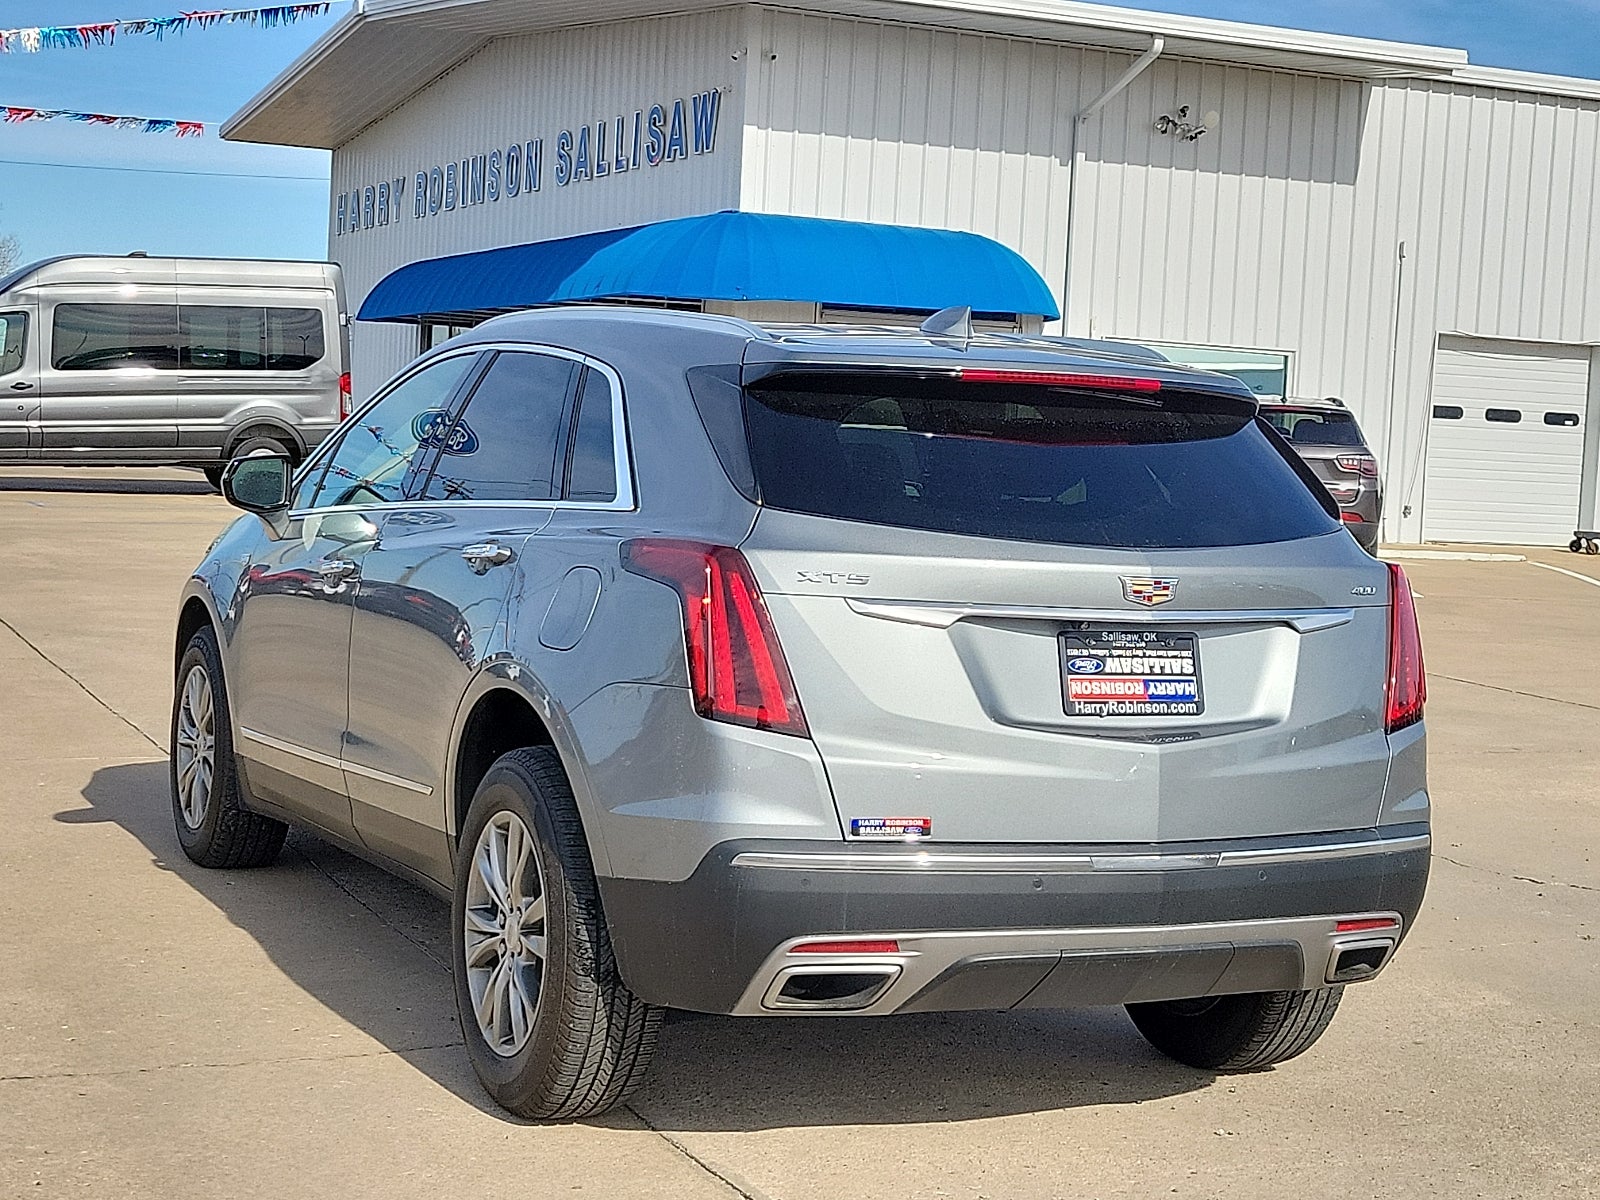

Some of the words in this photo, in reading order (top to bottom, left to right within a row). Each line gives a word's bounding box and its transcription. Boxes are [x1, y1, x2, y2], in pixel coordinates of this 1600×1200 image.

[335, 176, 406, 236] HARRY
[413, 136, 543, 219] ROBINSON
[554, 88, 722, 188] SALLISAW
[1101, 631, 1142, 643] Sallisaw,
[1143, 632, 1158, 642] OK
[1104, 657, 1195, 675] SALLISAW
[1070, 681, 1144, 695] ROBINSON
[1147, 681, 1196, 695] HARRY
[1075, 701, 1197, 717] HarryRobinson.com
